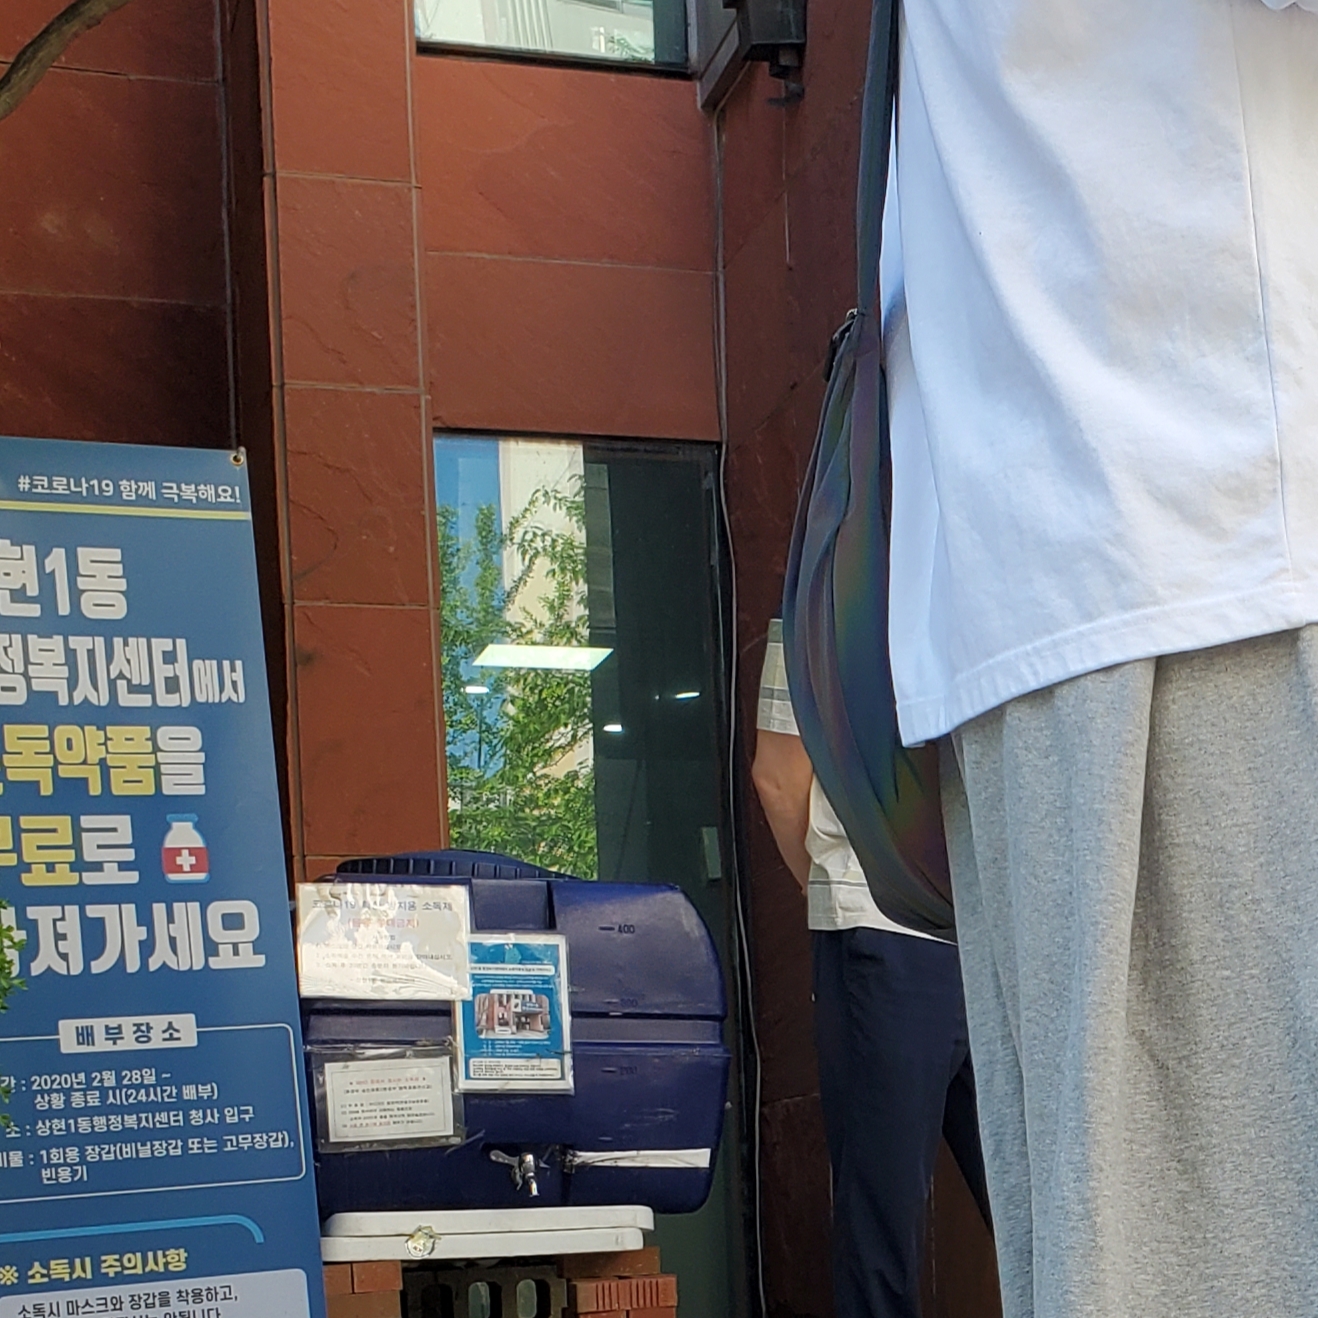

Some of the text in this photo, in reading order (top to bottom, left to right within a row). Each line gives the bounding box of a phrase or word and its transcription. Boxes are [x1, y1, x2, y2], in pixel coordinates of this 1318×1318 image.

[18, 475, 241, 503] #코로나19 함께 극복해요!
[0, 724, 206, 796] 독약품을
[617, 924, 635, 934] 400
[75, 1021, 182, 1047] 배부장소
[31, 1071, 86, 1091] 2020년
[91, 1069, 116, 1087] 2월
[121, 1068, 157, 1086] 28일
[34, 1082, 219, 1111] 상황 종료 시(24시간 배부)
[36, 1109, 184, 1137] 상현1동행정복지센터
[189, 1107, 220, 1127] 청사
[224, 1105, 255, 1124] 입구
[40, 1147, 81, 1165] 1회용
[85, 1138, 183, 1162] 장갑(비닐장갑
[187, 1136, 218, 1154] 또는
[222, 1130, 295, 1152] 고무장갑),
[42, 1165, 88, 1185] 빈용기
[28, 1256, 93, 1284] 소독시
[101, 1248, 188, 1278] 주의사항
[66, 1295, 124, 1317] 마스크와
[128, 1291, 171, 1311] 장갑을
[176, 1285, 239, 1307] 착용하고,
